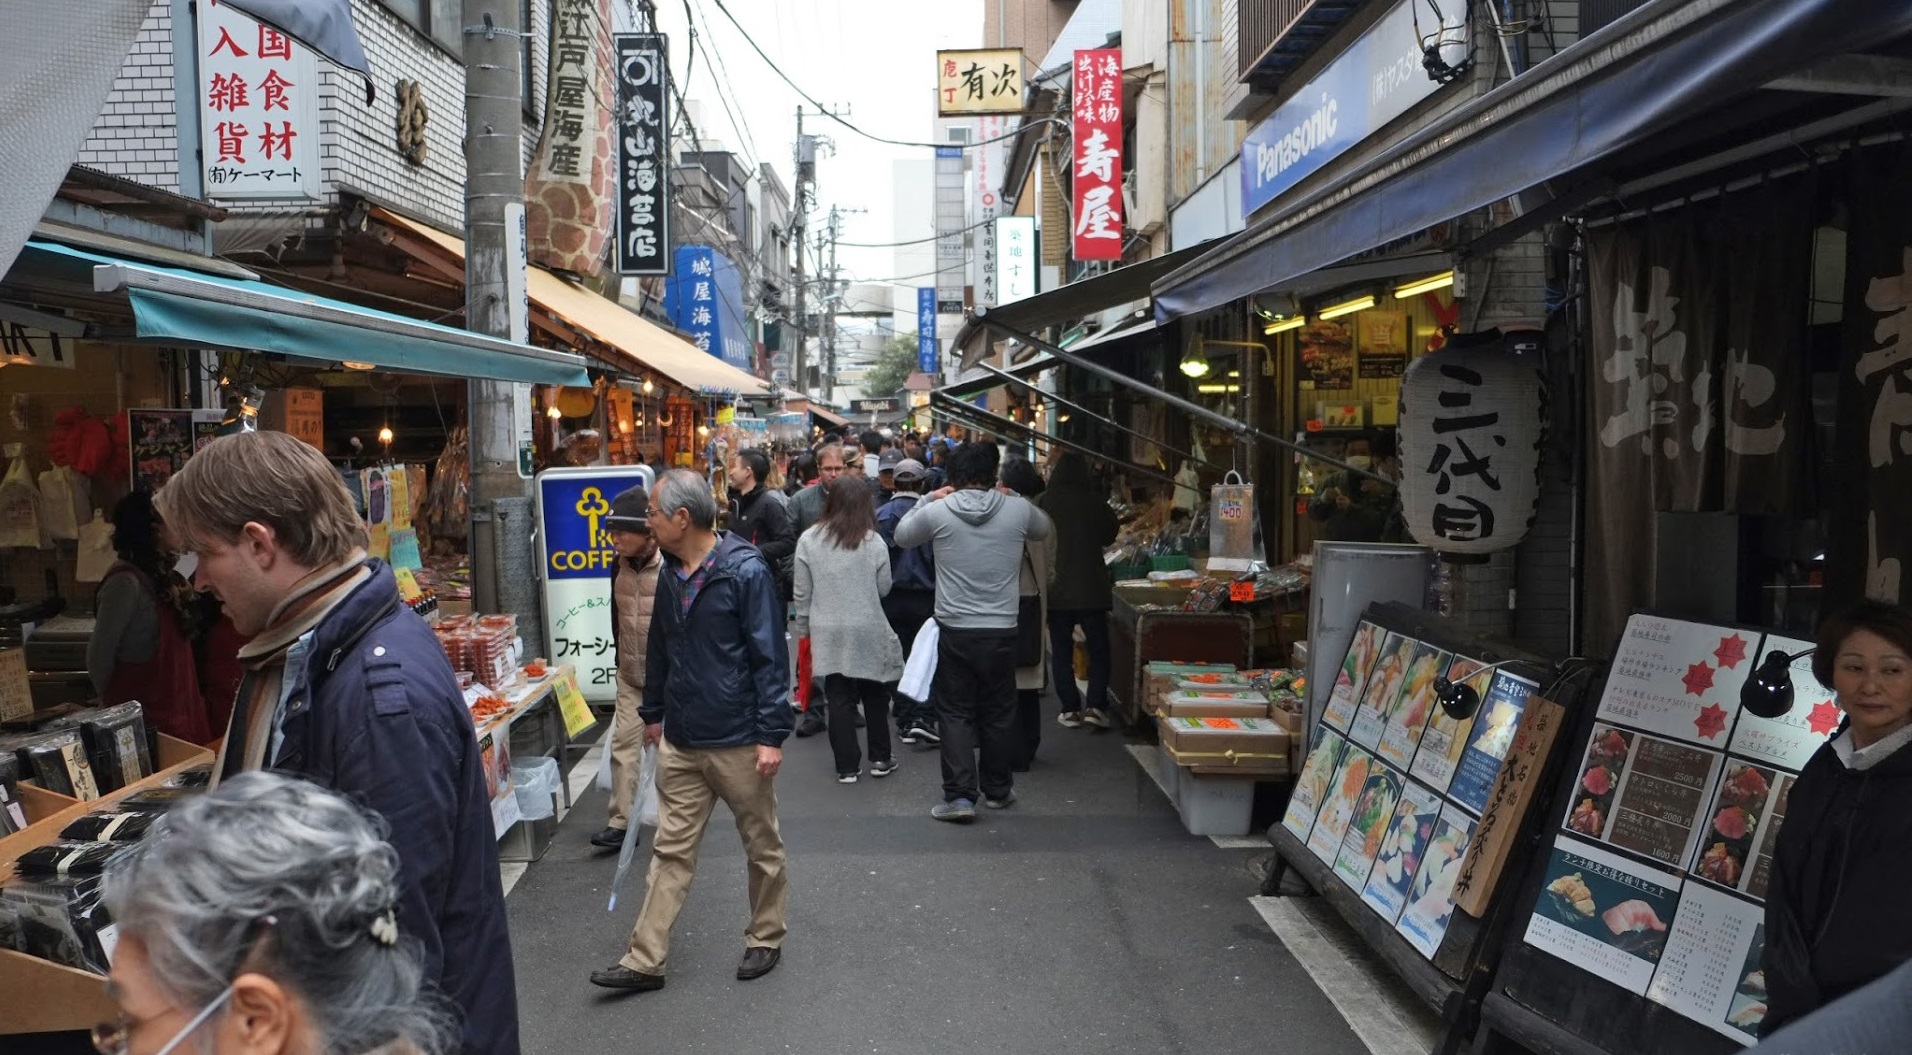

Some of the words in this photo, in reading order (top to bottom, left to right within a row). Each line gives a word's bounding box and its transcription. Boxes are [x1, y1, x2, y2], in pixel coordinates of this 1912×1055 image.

[207, 0, 250, 164] 入雑貨
[549, 0, 592, 177] 江戸屋海産
[961, 62, 1019, 101] 有次
[1097, 55, 1120, 124] 海産物
[1076, 129, 1120, 239] 寿屋
[1257, 92, 1338, 188] Panasonic
[1008, 229, 1022, 296] 築地すし
[1427, 364, 1506, 542] 三代目
[591, 668, 616, 685] 2F
